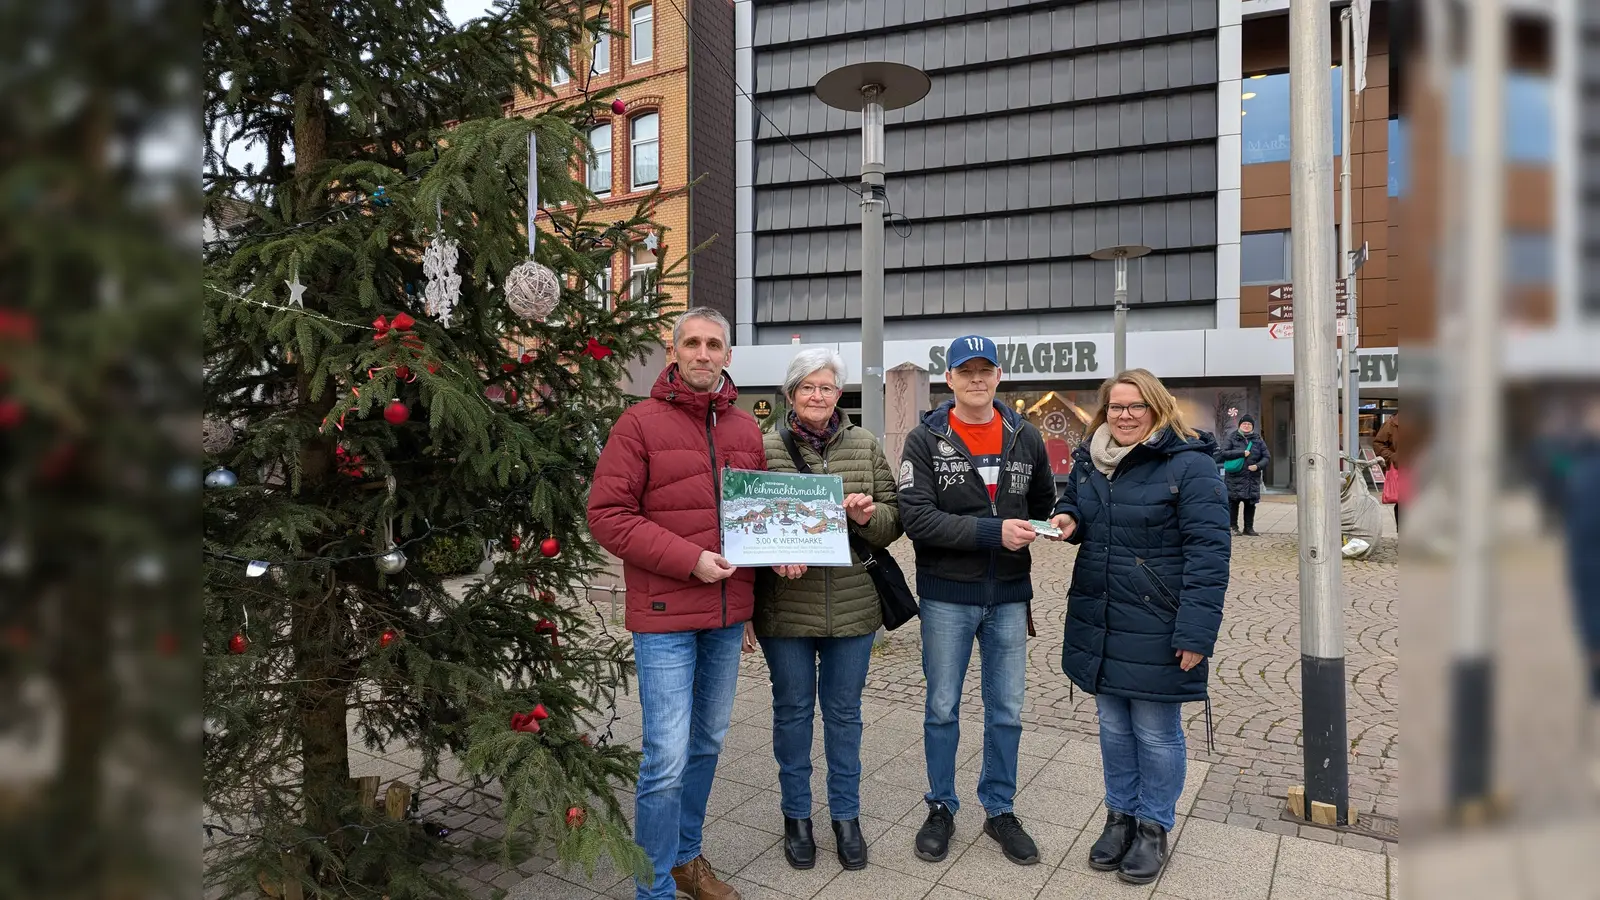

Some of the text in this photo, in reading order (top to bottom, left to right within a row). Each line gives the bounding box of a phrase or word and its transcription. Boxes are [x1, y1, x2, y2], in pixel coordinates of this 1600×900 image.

[929, 341, 1098, 375] SWAGER
[743, 477, 828, 496] Weihnachtsmarkt
[938, 473, 965, 491] 1963
